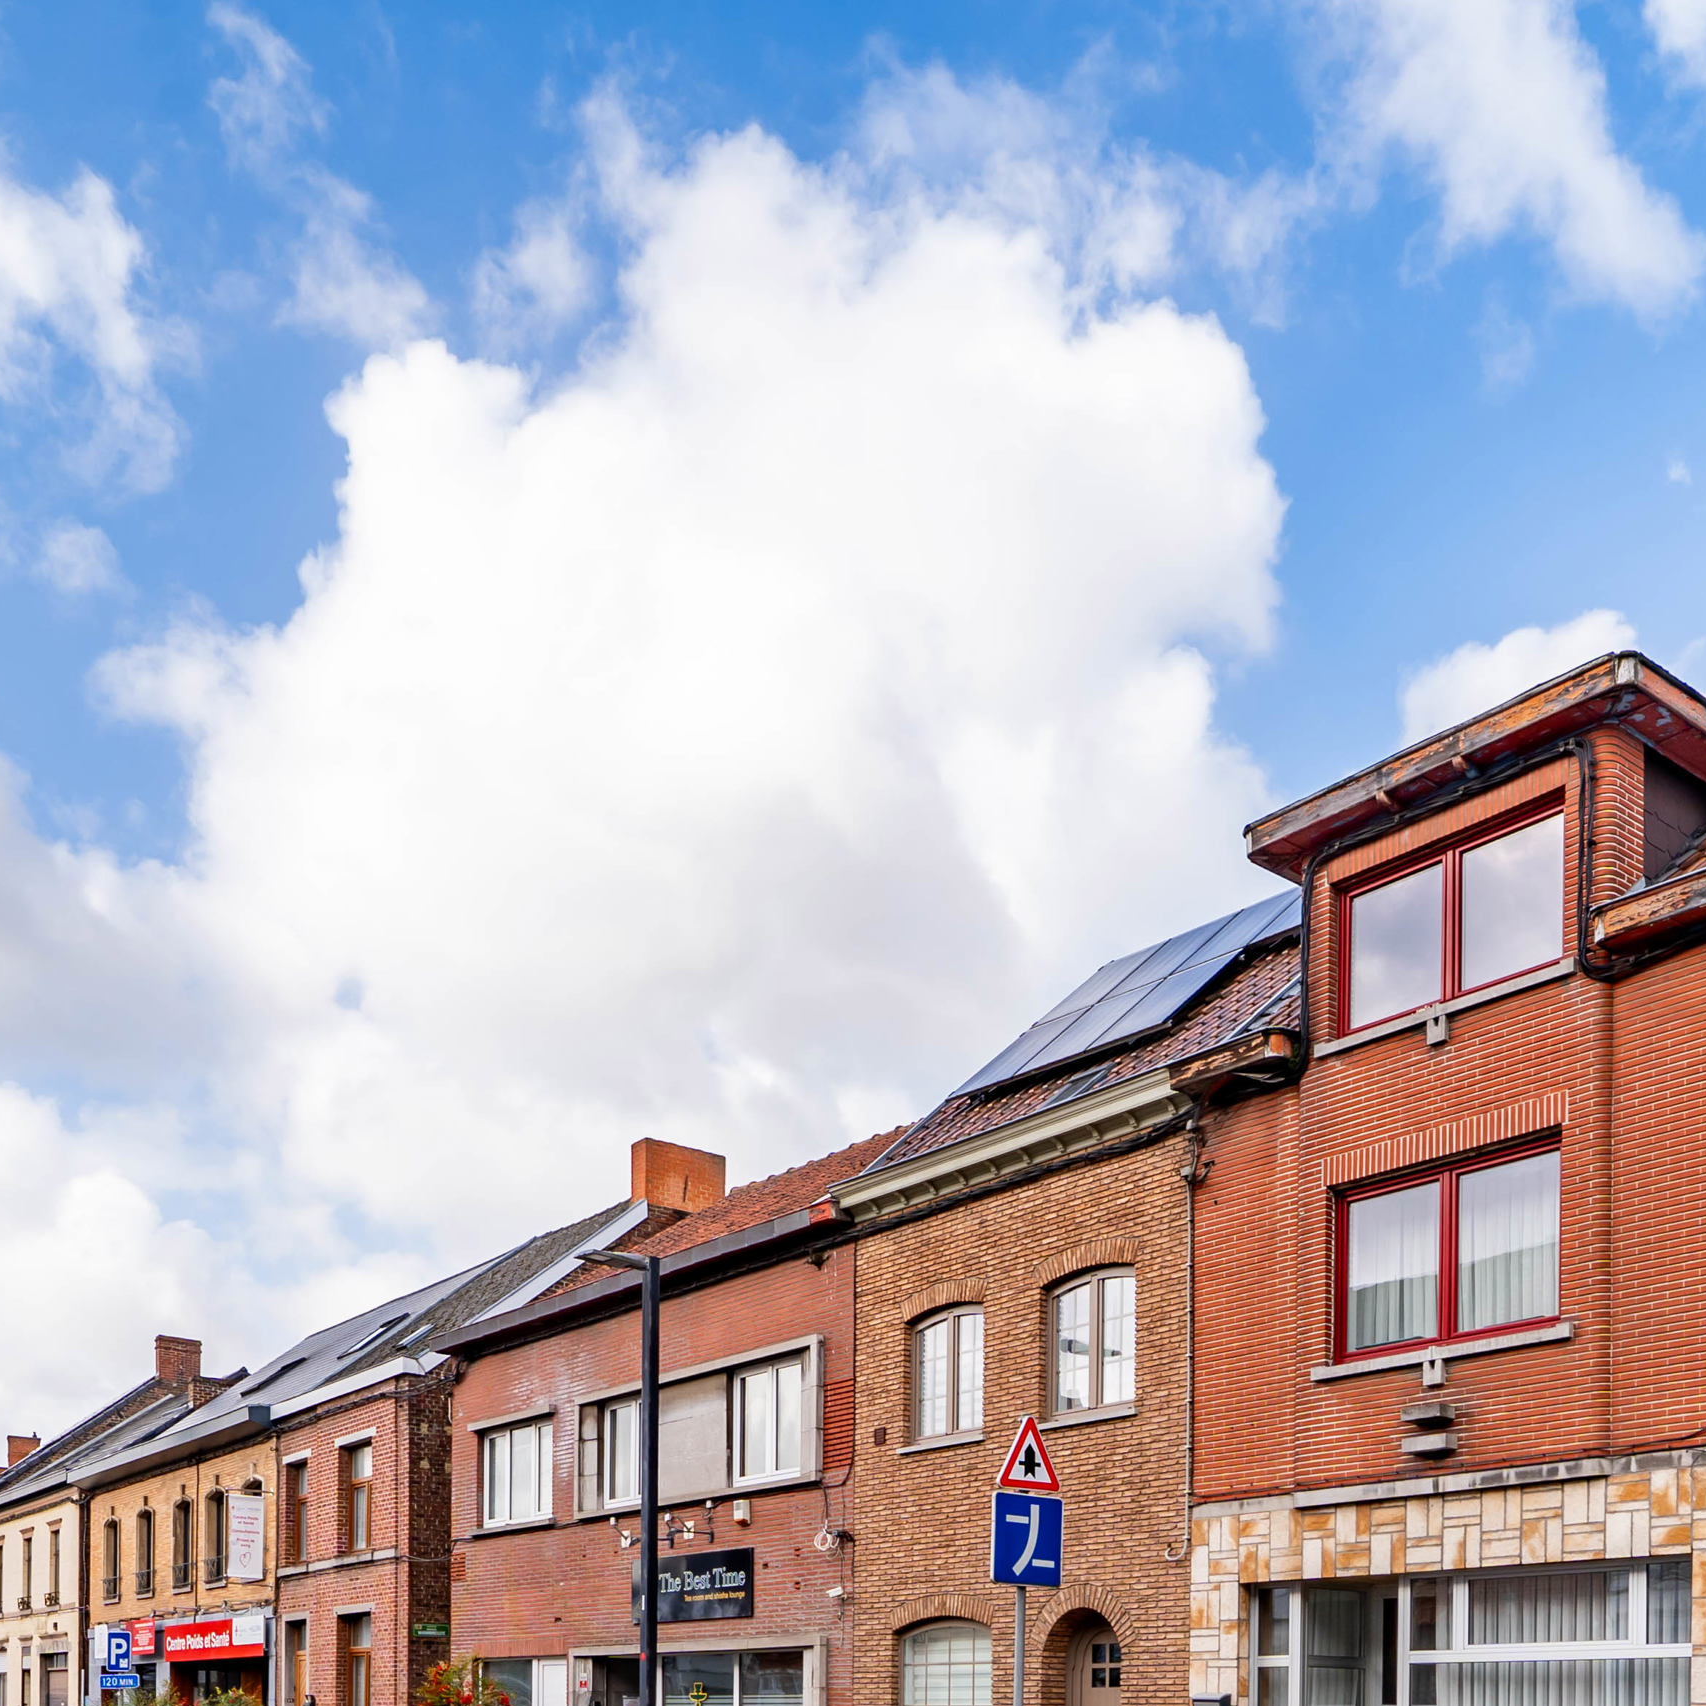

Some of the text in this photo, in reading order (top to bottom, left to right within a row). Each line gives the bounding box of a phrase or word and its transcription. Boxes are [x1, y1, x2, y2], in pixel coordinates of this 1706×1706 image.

[658, 1566, 746, 1593] The Best Time
[110, 1638, 128, 1665] P
[166, 1636, 186, 1652] Centre
[186, 1633, 204, 1650] Poids
[204, 1634, 211, 1649] et
[211, 1630, 230, 1648] Santé
[102, 1677, 118, 1687] 120
